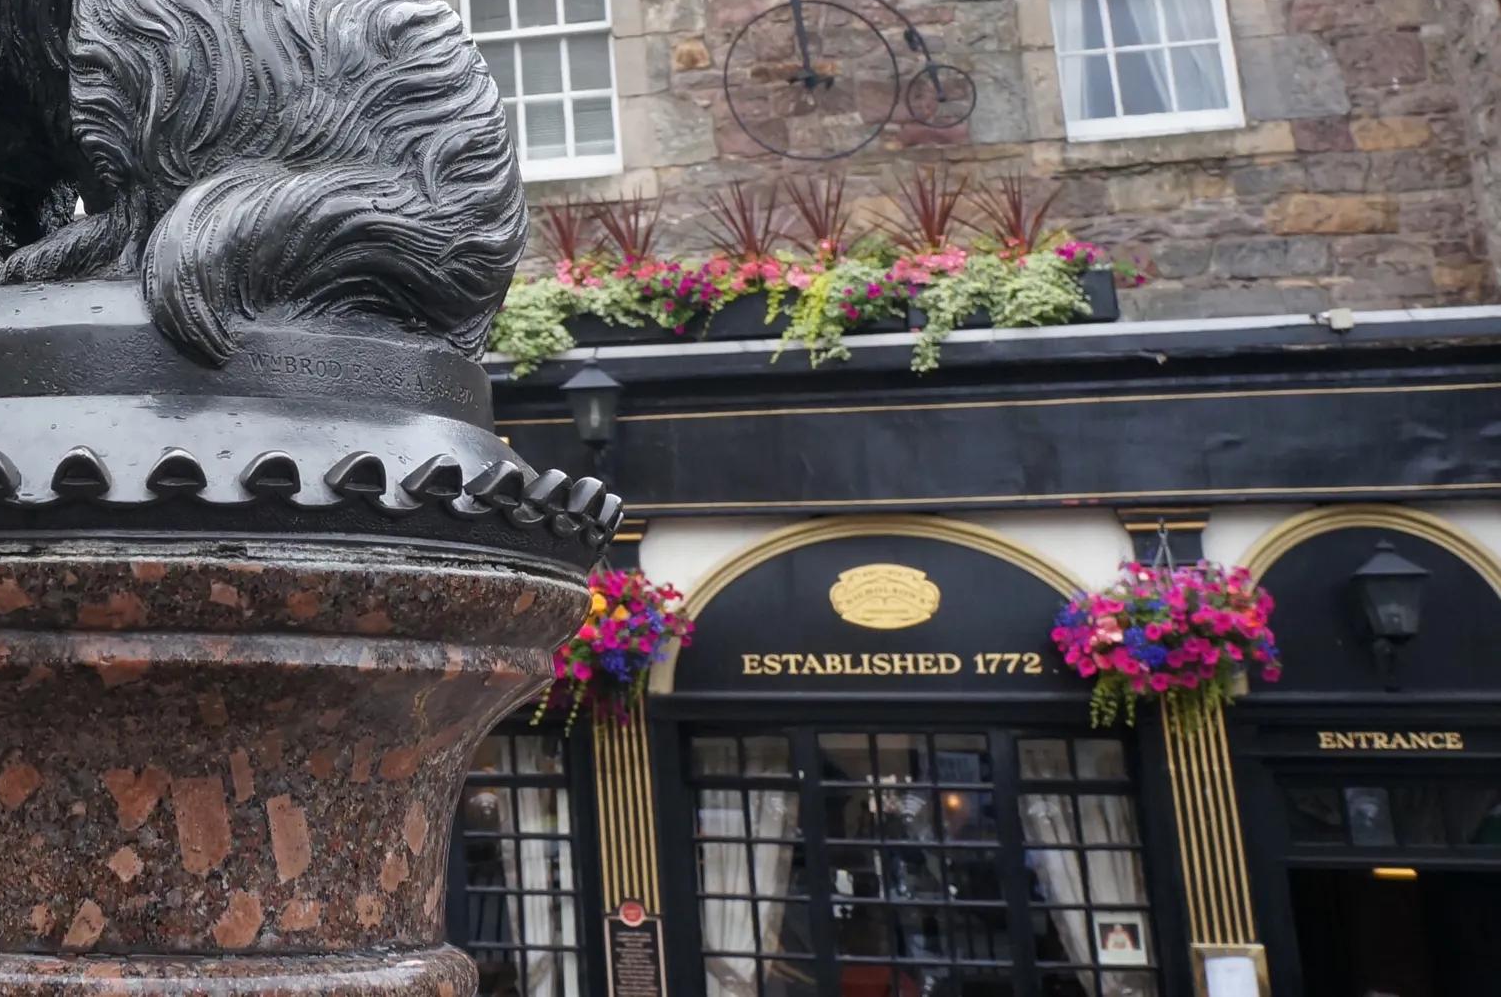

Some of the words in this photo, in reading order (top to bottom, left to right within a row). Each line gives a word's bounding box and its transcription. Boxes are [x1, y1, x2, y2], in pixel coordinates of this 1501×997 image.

[742, 653, 962, 675] ESTABLISHED
[973, 653, 1043, 675] 1772
[1317, 731, 1464, 749] ENTRANCE
